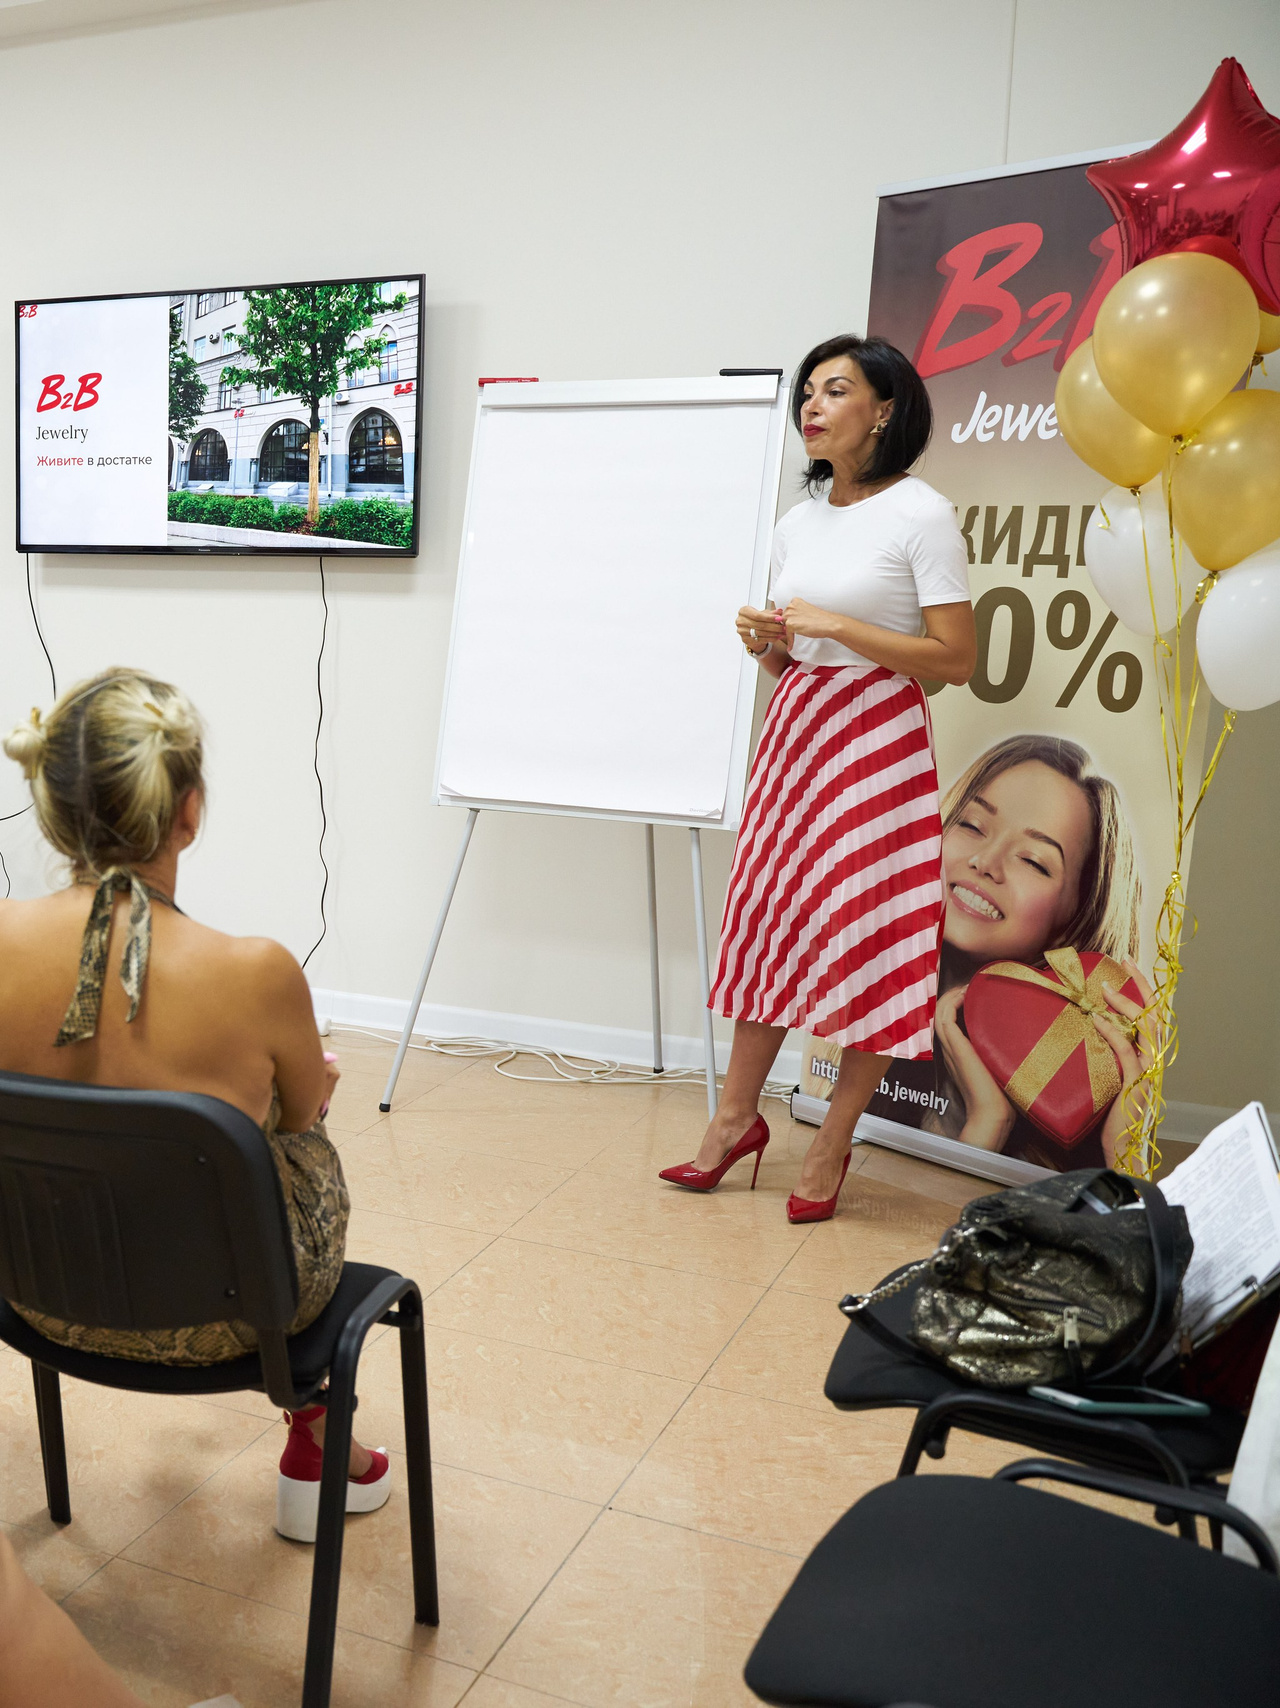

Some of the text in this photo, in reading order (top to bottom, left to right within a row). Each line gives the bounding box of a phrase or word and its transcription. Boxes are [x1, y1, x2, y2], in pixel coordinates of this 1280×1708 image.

[19, 304, 38, 318] B2B
[36, 372, 103, 413] B2B
[951, 391, 1063, 444] Jewe
[36, 425, 89, 443] Jewelry
[36, 455, 153, 468] Живите в достатке
[926, 586, 1144, 714] 0%
